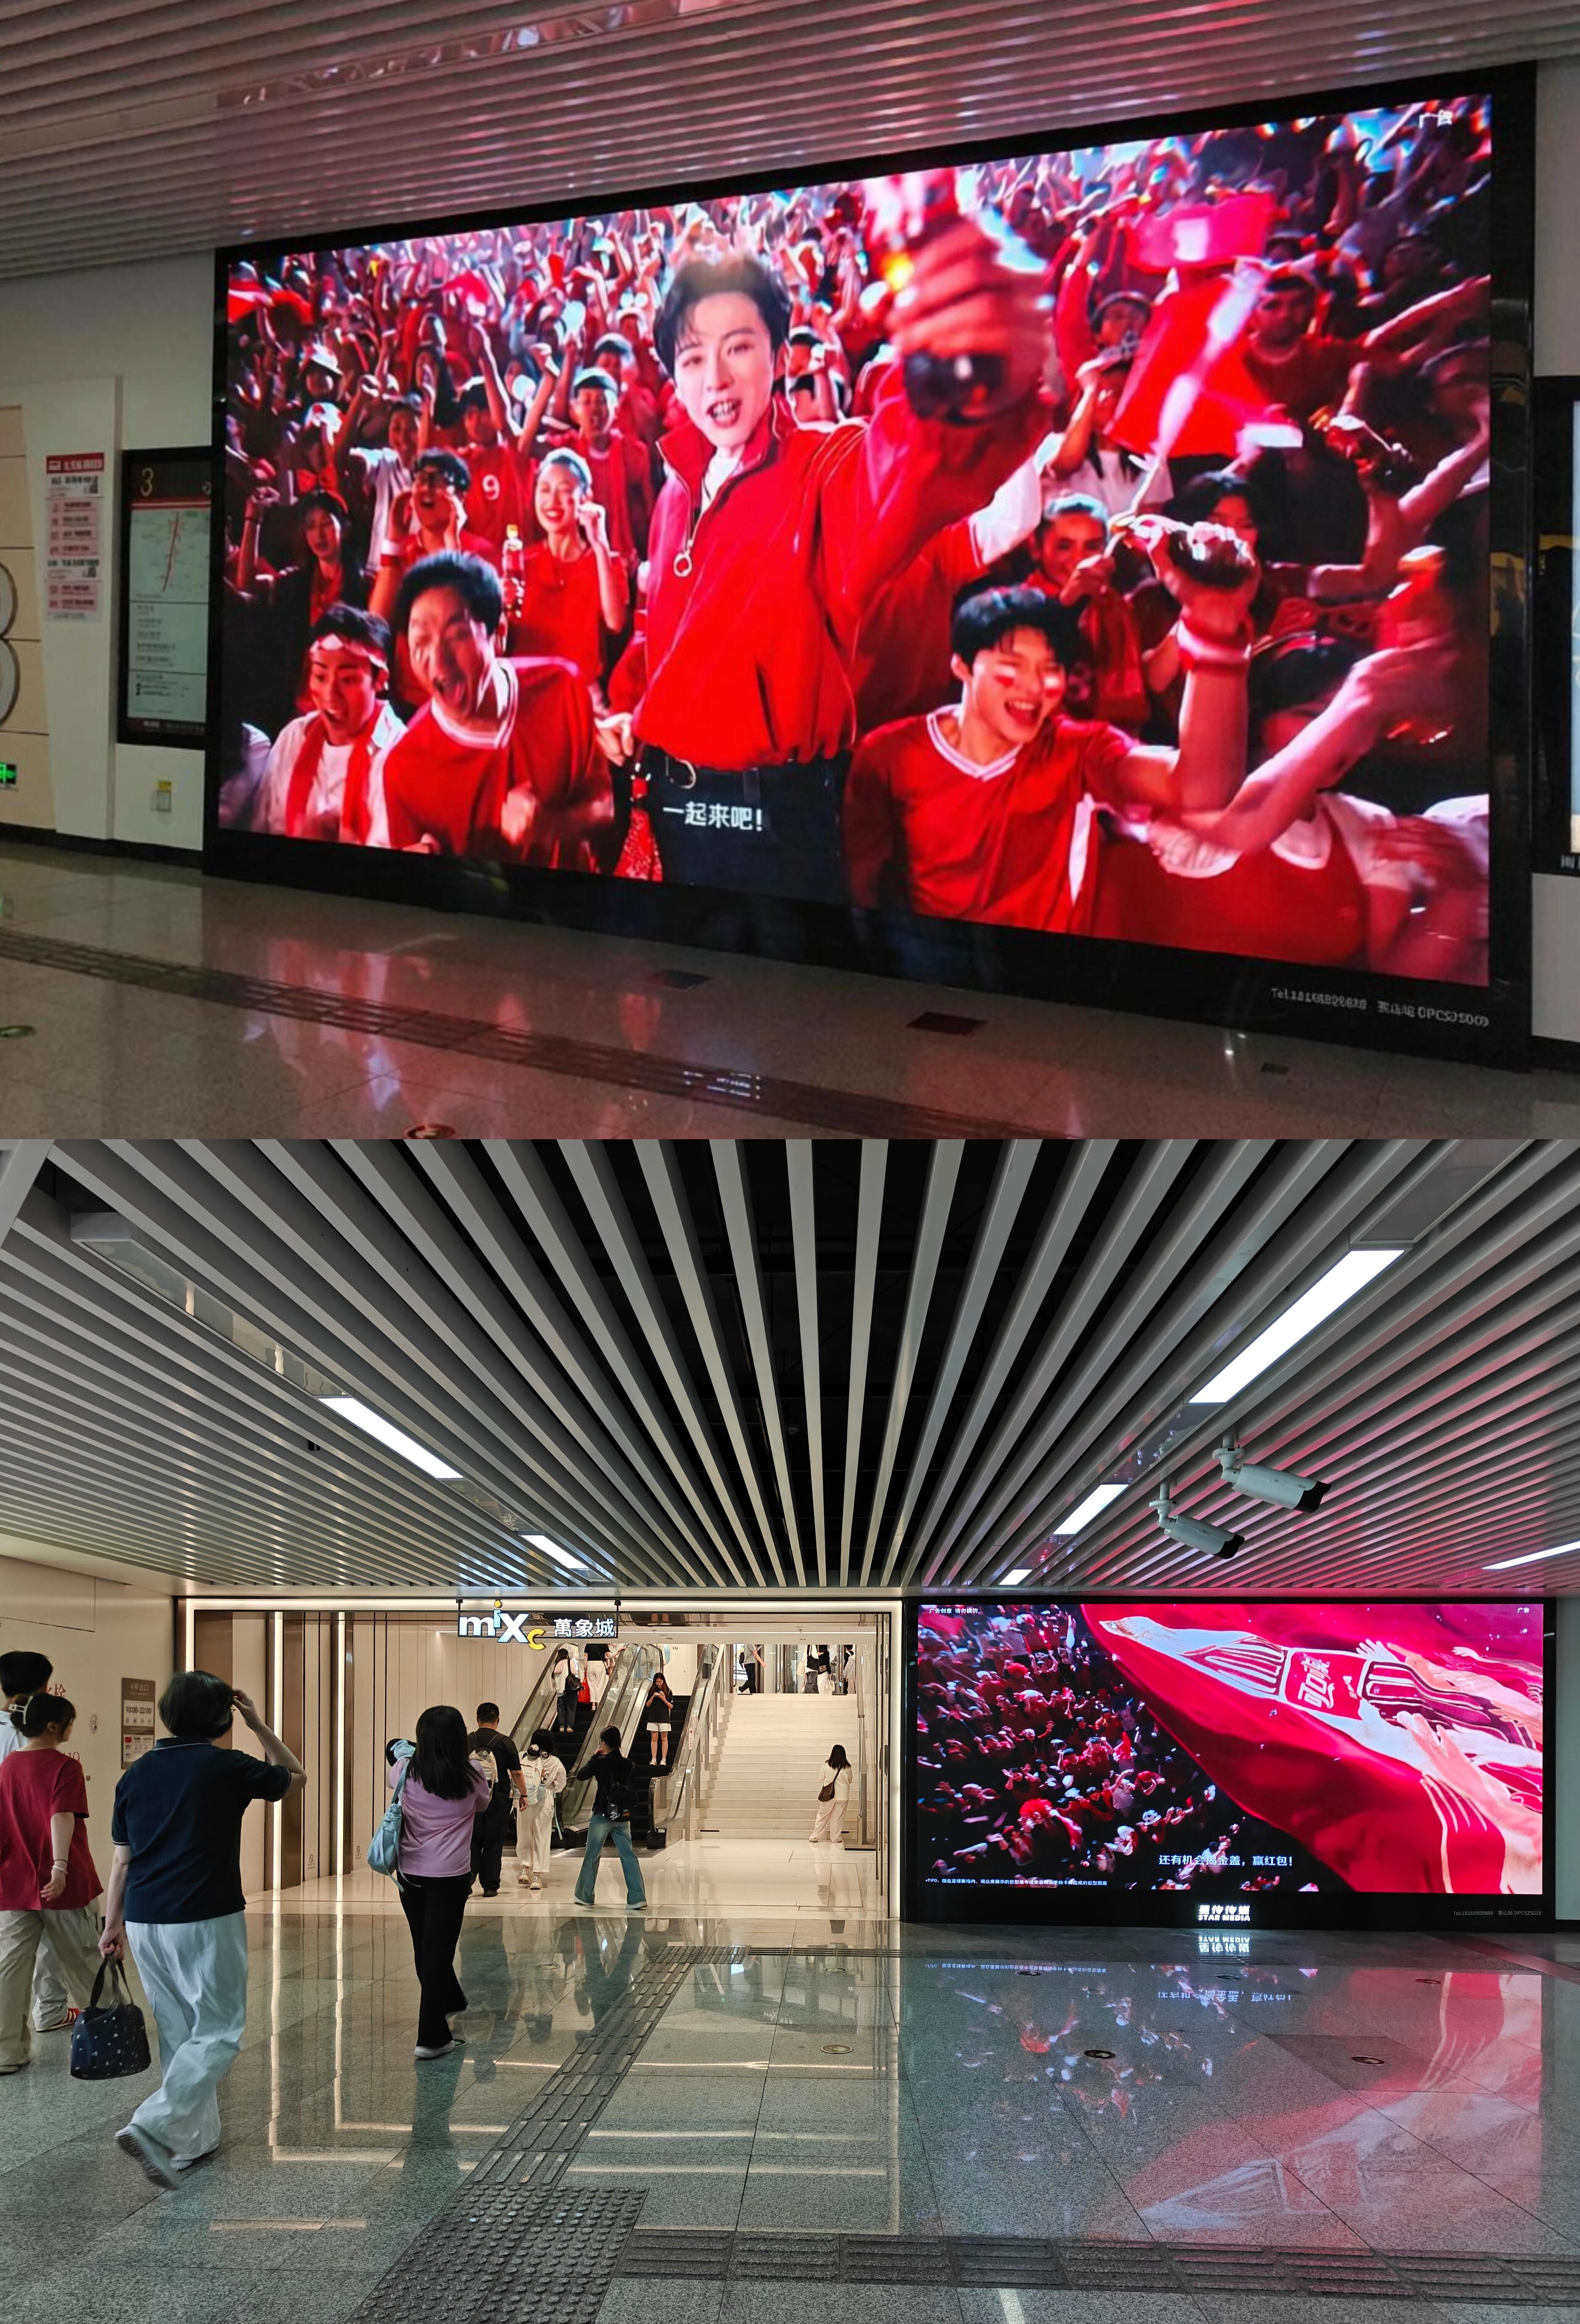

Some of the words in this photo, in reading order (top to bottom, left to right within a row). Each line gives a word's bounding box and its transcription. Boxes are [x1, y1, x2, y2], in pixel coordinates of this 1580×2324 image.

[483, 474, 500, 500] 9
[554, 1618, 614, 1638] 萬象城
